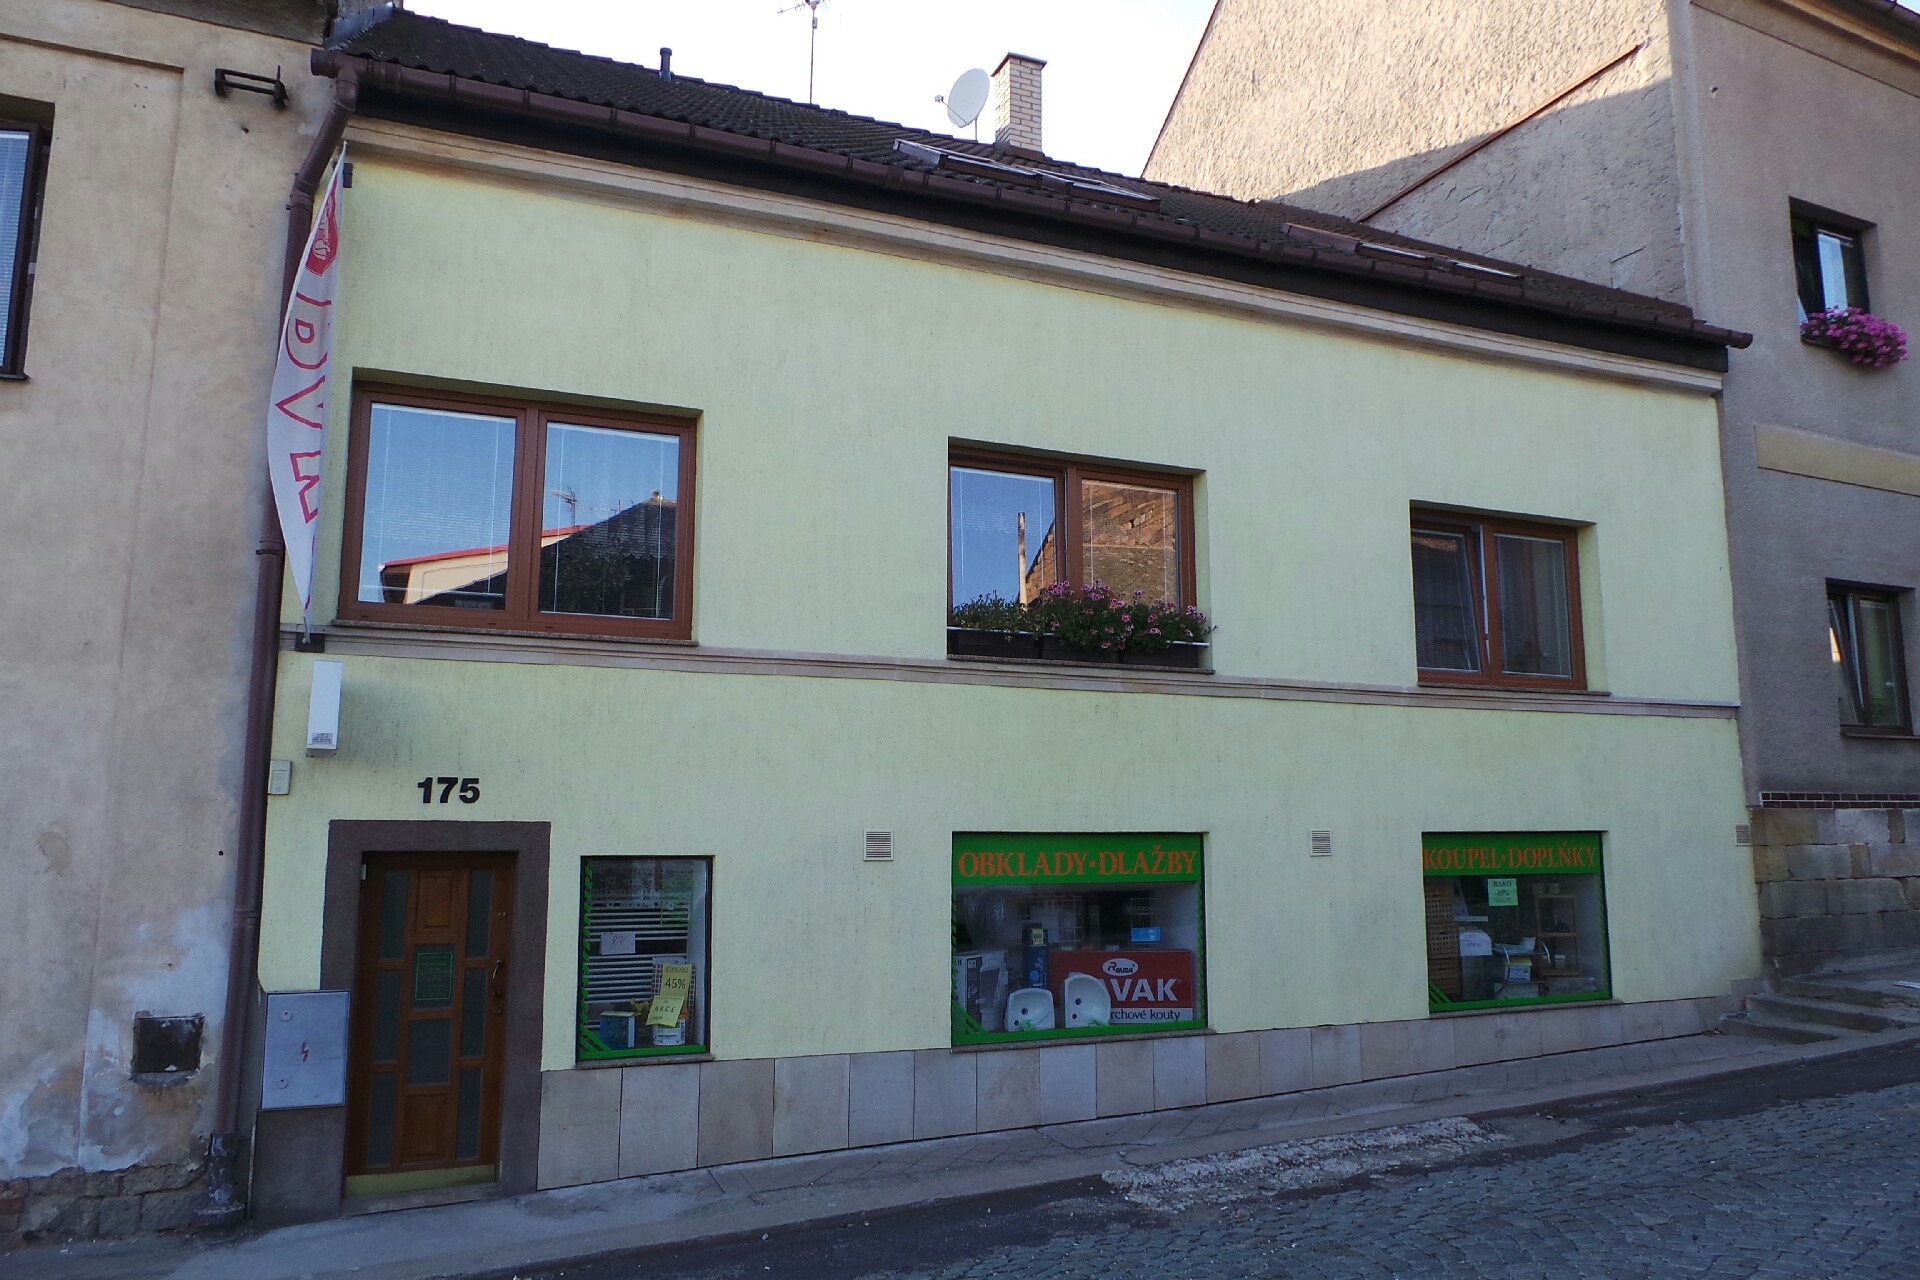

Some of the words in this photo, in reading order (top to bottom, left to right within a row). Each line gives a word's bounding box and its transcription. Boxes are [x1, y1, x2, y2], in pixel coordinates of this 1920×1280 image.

[417, 776, 481, 804] 175
[958, 851, 1090, 877] OBKLADY
[1097, 844, 1197, 875] DLAŽBY
[1422, 847, 1501, 870] KOUPEL
[1507, 841, 1596, 869] DOPLŇKY
[664, 977, 686, 989] 45%
[1096, 978, 1179, 1002] VAK
[1110, 1009, 1147, 1020] rchové
[1150, 1009, 1181, 1022] kouty
